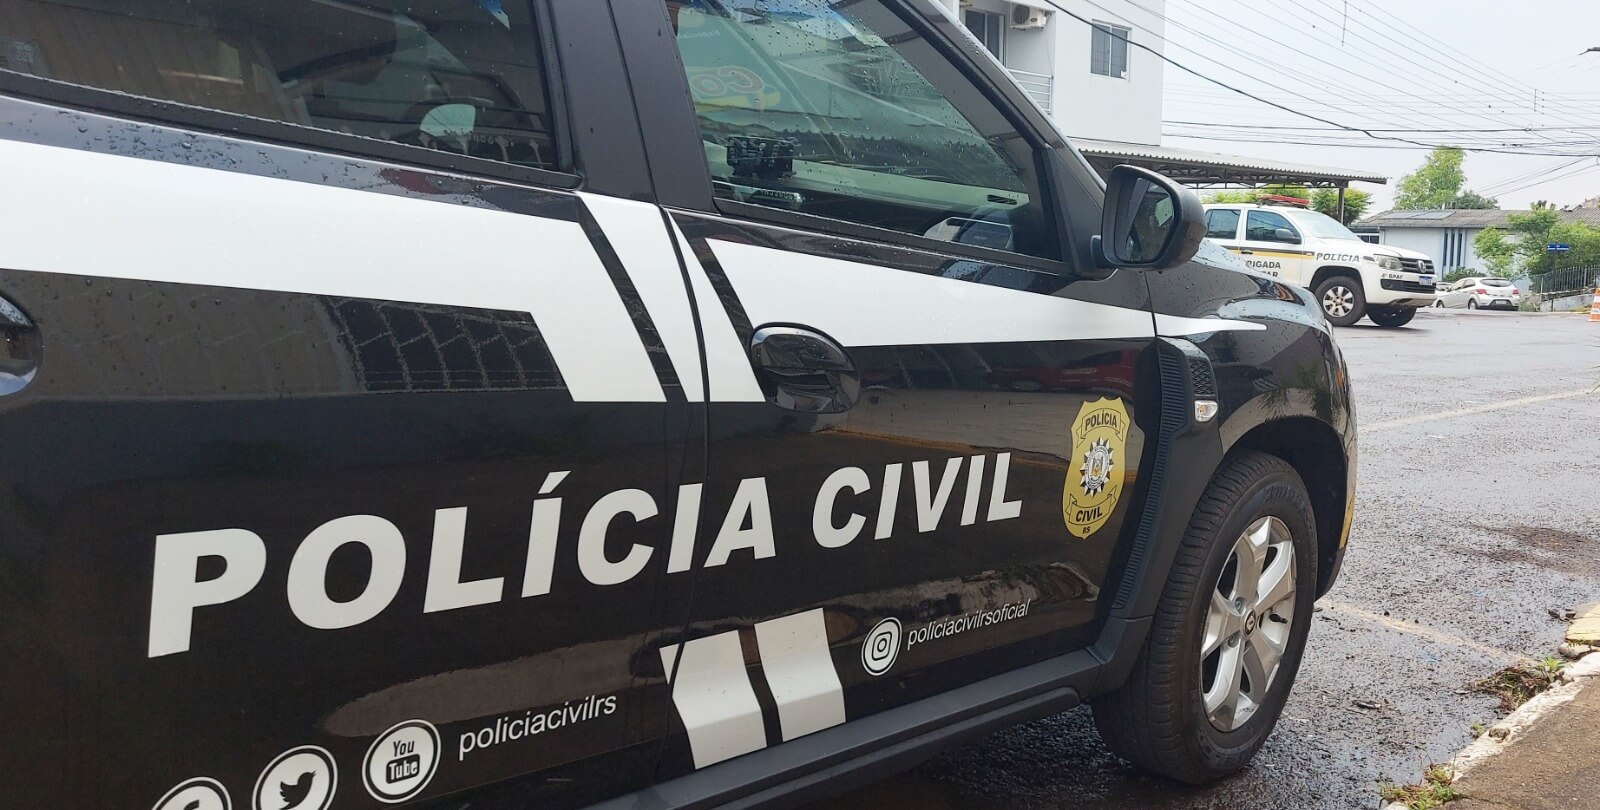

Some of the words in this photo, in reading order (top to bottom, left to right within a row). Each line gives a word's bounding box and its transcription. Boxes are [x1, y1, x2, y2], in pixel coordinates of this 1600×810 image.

[1085, 410, 1118, 431] POLÍCIA
[1076, 506, 1103, 523] CIVIL
[1082, 526, 1091, 534] RS
[148, 471, 776, 657] POLÍCIA
[812, 452, 1022, 548] CIVIL
[907, 598, 1031, 651] policiacivilrsoficial
[458, 693, 617, 761] policiacivilrs
[393, 740, 415, 757] You
[389, 760, 418, 780] Tube
